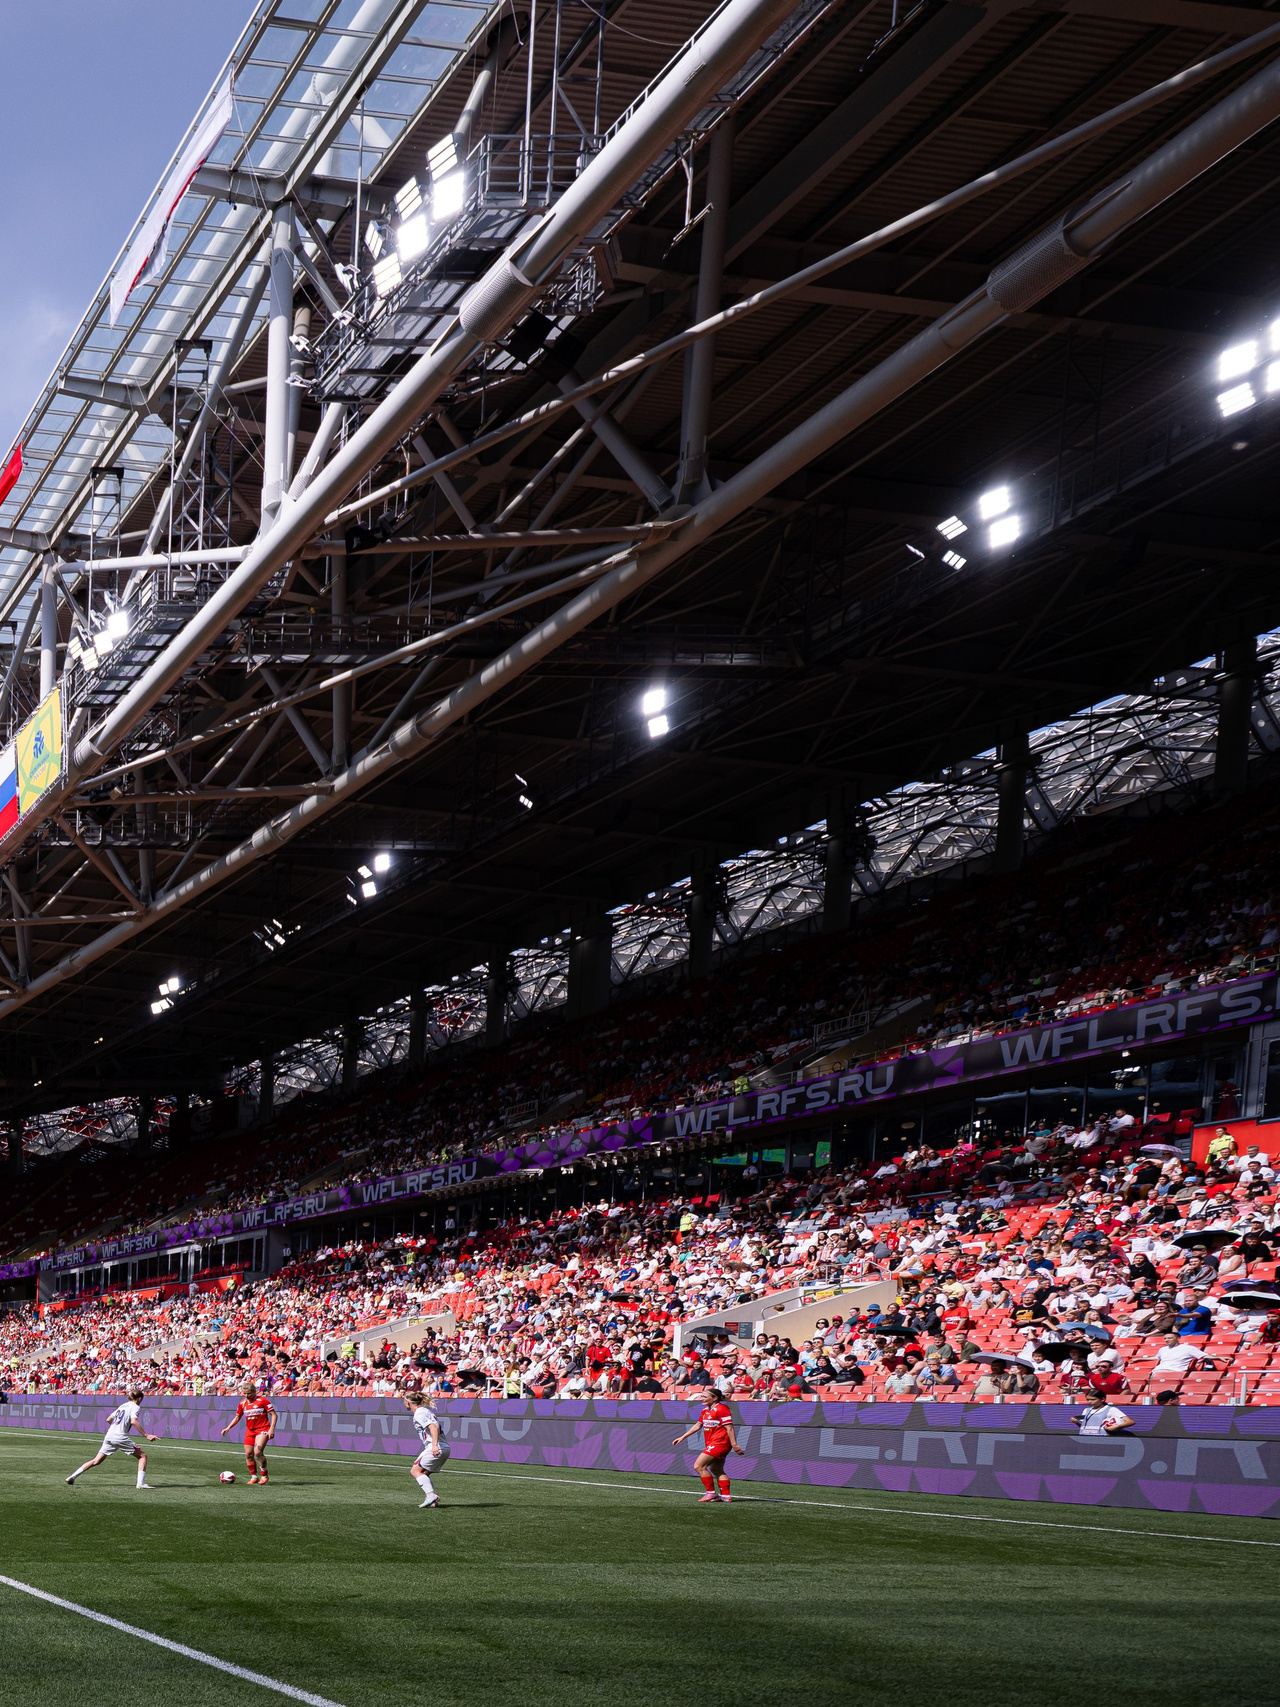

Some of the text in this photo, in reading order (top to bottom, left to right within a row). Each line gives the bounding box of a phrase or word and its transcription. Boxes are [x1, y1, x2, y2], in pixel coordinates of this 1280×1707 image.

[1000, 981, 1280, 1067] WFL.RFS.
[674, 1066, 894, 1136] WFL.RFS.RU
[362, 1161, 477, 1203] WFL.RFS.RU
[242, 1195, 327, 1229] WFL.RFS.RU
[40, 1250, 85, 1271] WFL.RFS.RU
[101, 1233, 158, 1258] WFL.RFS.RU
